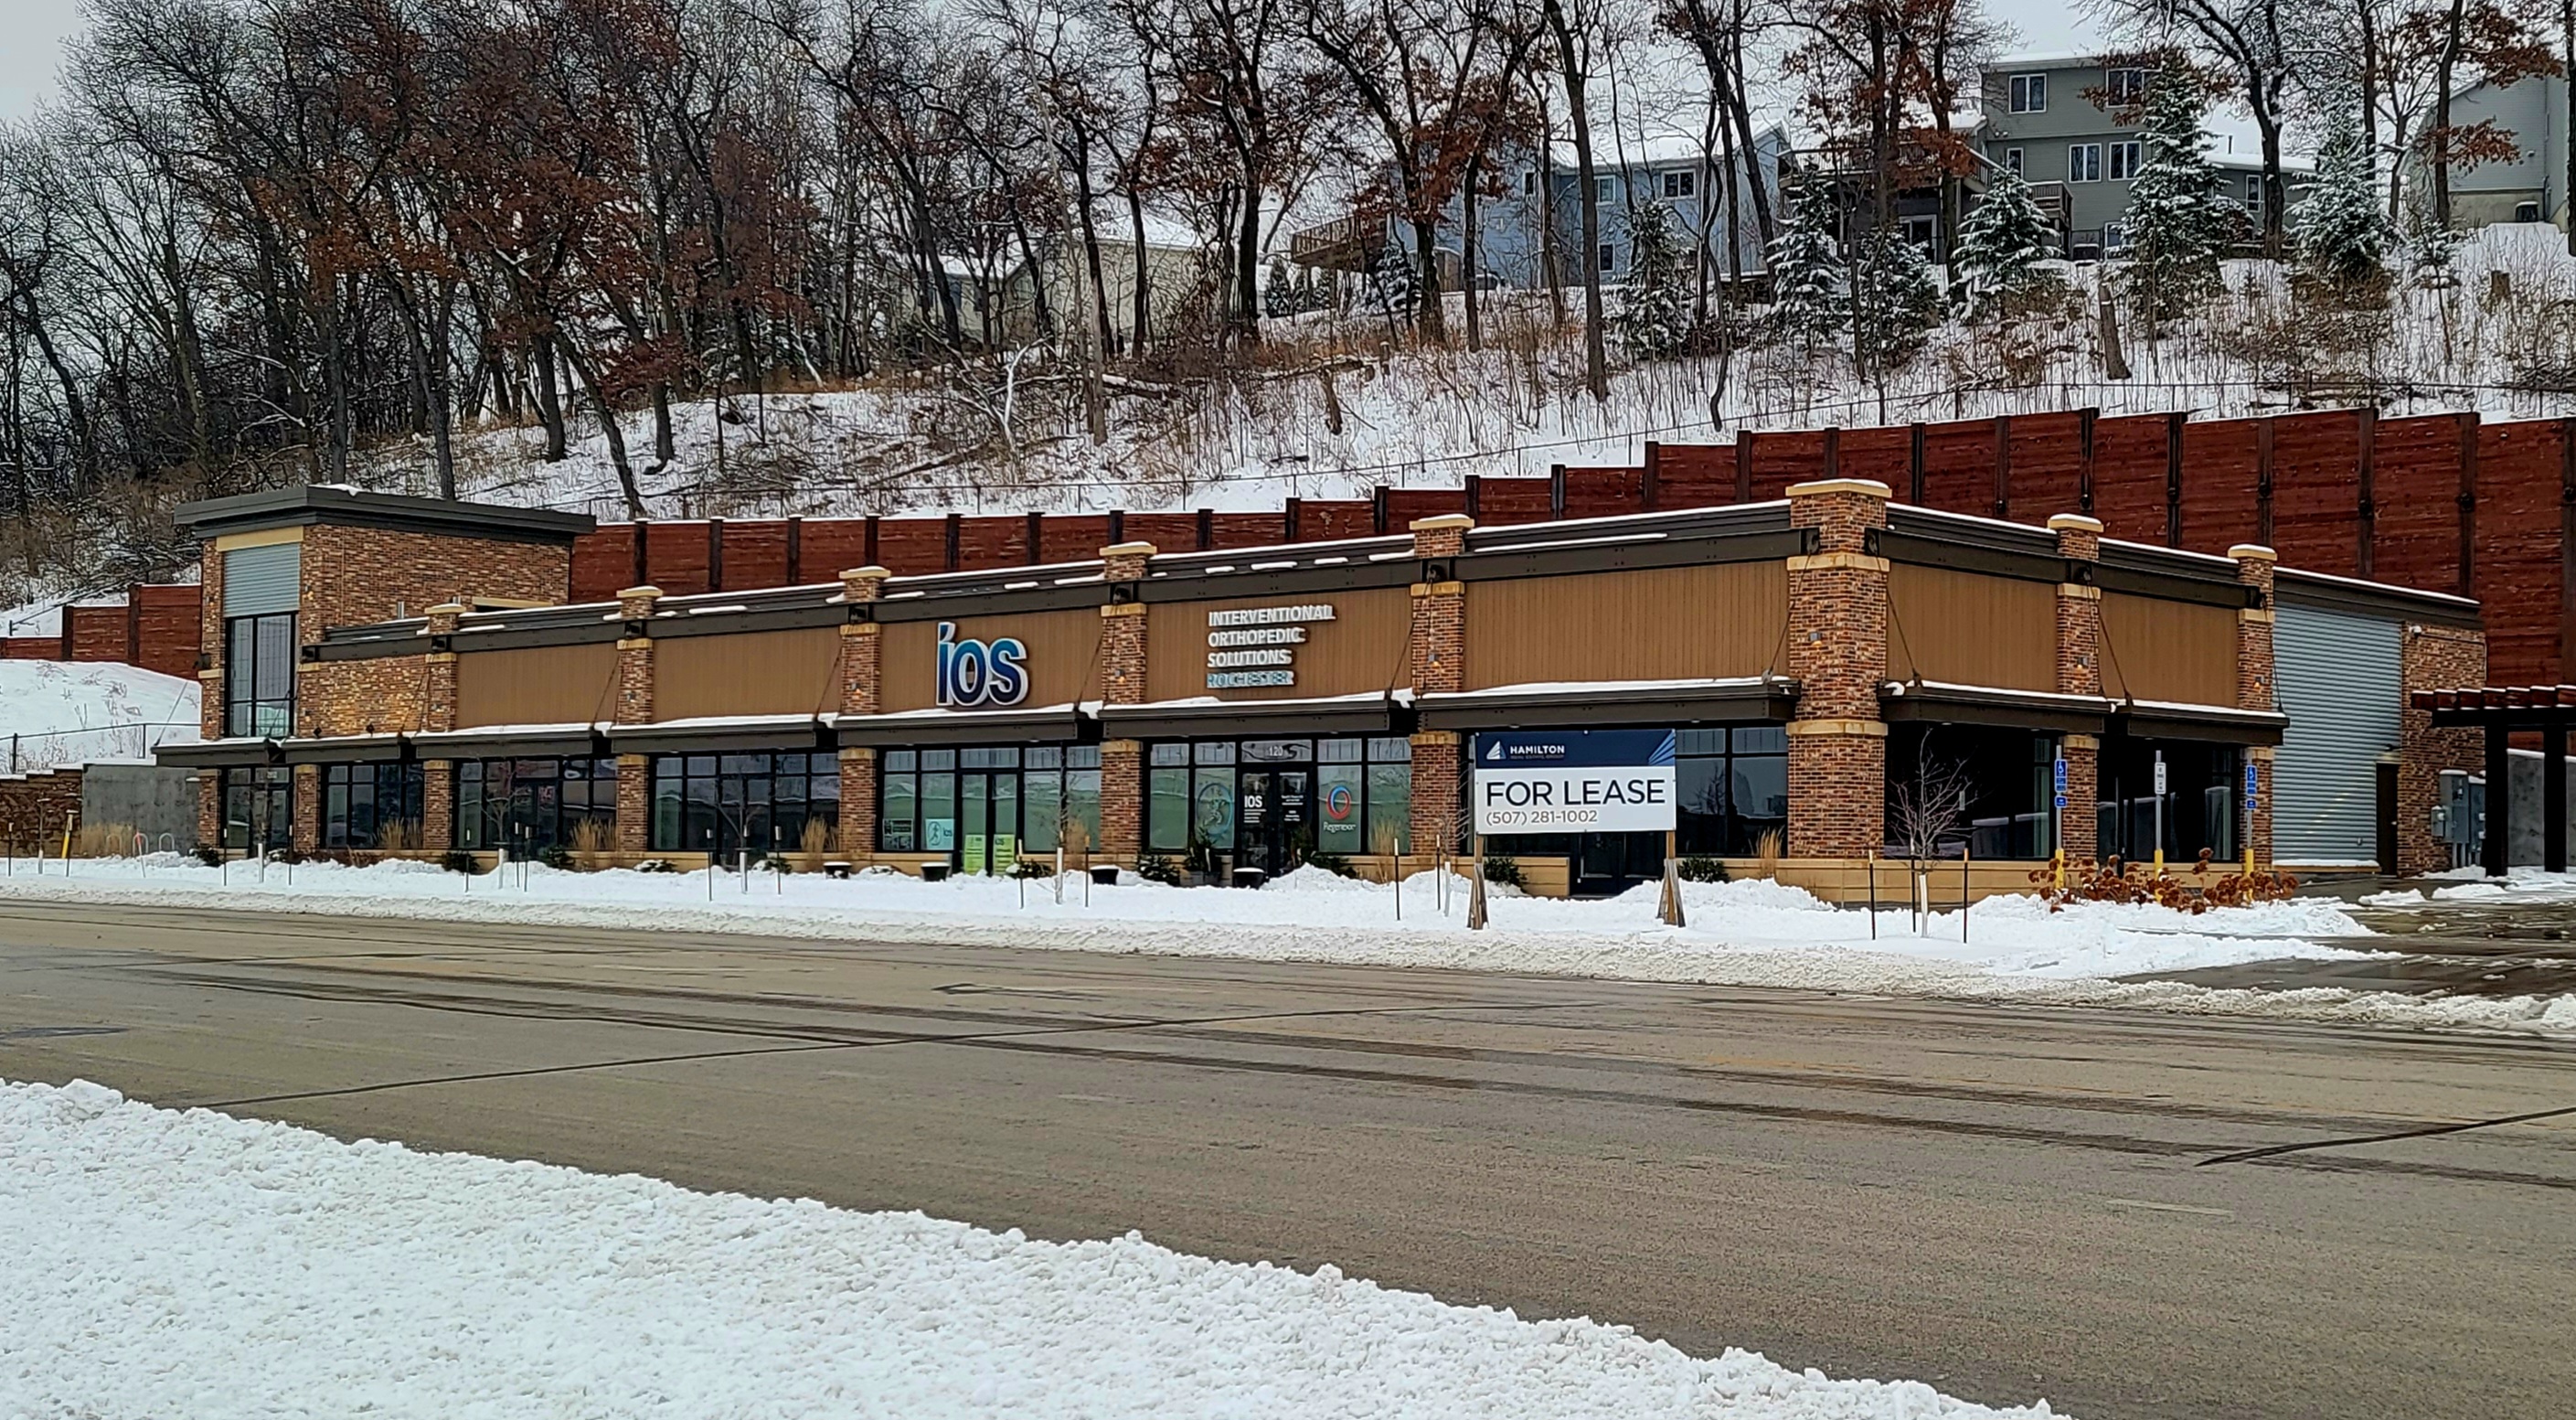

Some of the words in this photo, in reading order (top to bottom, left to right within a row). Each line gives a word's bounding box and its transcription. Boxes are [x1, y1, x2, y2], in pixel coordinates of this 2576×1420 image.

[1208, 603, 1336, 627] INTERVENTIONAL
[1208, 626, 1307, 647] ORTHOPEDIC
[1207, 648, 1293, 668] SOLUTIONS
[1207, 669, 1294, 689] ROCHESTER
[1509, 744, 1566, 754] HAMILTON
[1243, 795, 1263, 808] IOS
[1485, 781, 1554, 807] FOR
[1563, 779, 1666, 806] LEASE
[1485, 810, 1528, 827] (507)
[1530, 809, 1599, 824] 281-1002
